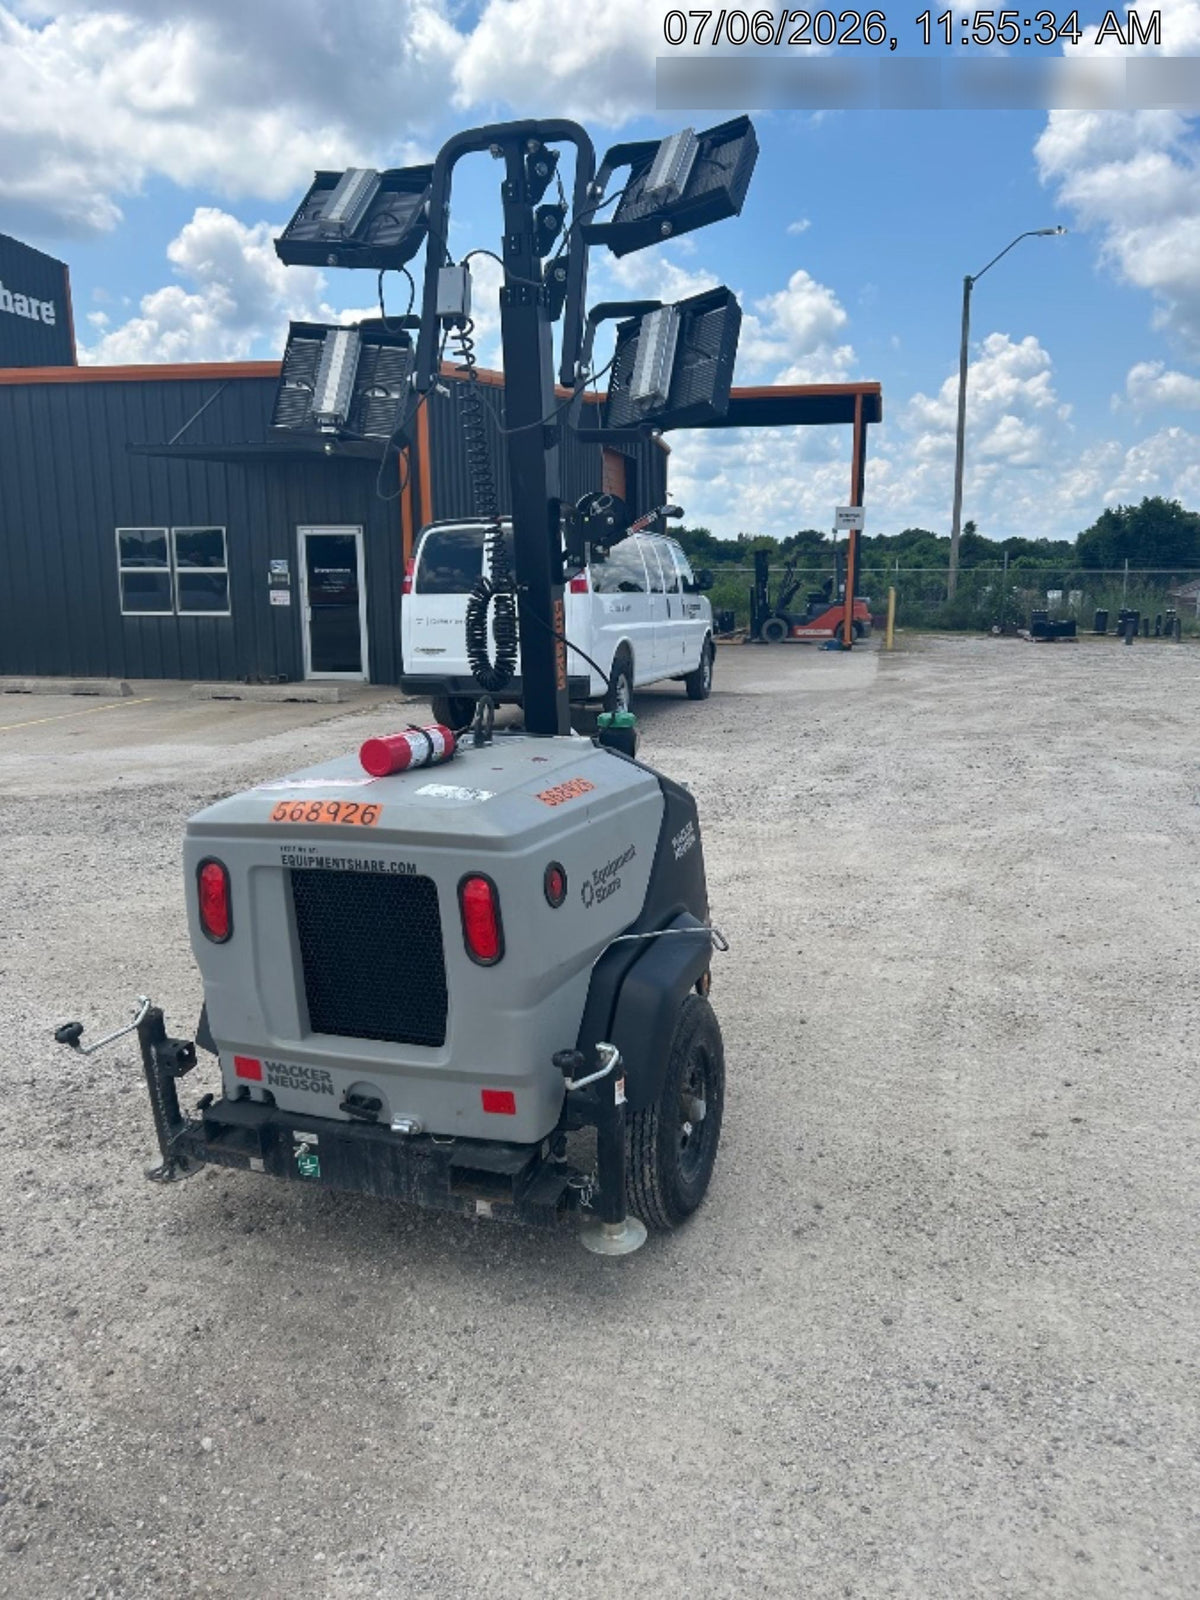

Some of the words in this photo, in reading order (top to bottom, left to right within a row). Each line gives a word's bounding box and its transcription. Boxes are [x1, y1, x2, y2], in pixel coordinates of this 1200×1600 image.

[272, 801, 380, 826] 568926
[281, 854, 417, 875] EQUIPMENTSHARE.COM
[265, 1060, 333, 1084] WACKER
[267, 1073, 335, 1096] NEUSON
